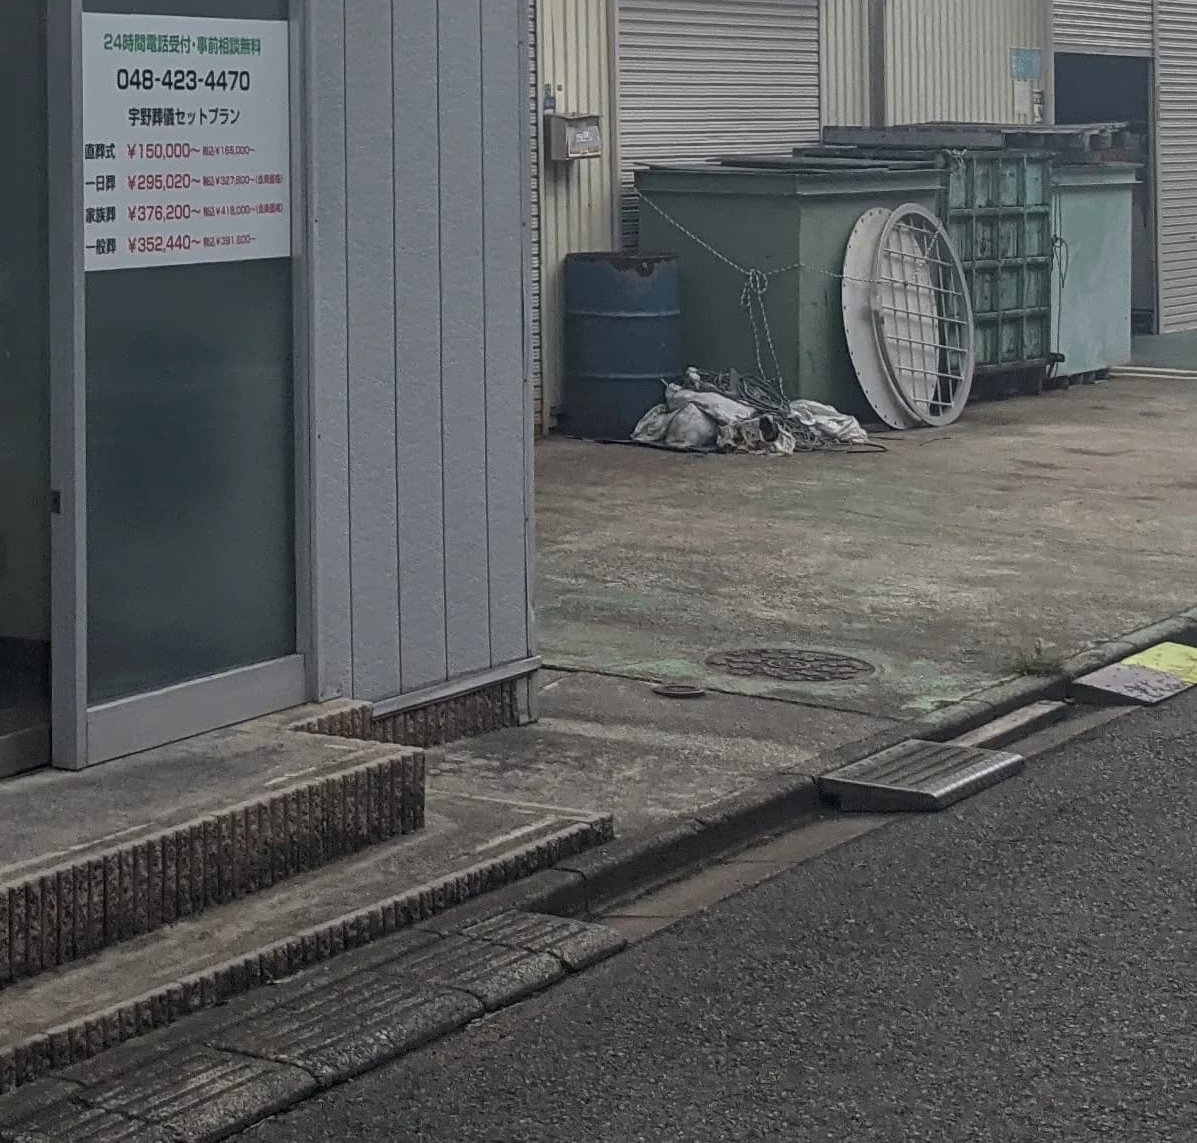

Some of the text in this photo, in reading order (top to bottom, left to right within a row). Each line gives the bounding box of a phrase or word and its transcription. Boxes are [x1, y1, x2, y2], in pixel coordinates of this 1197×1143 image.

[116, 69, 251, 91] 048-423-4470
[128, 107, 241, 127] 宇野葬儀セットプラン
